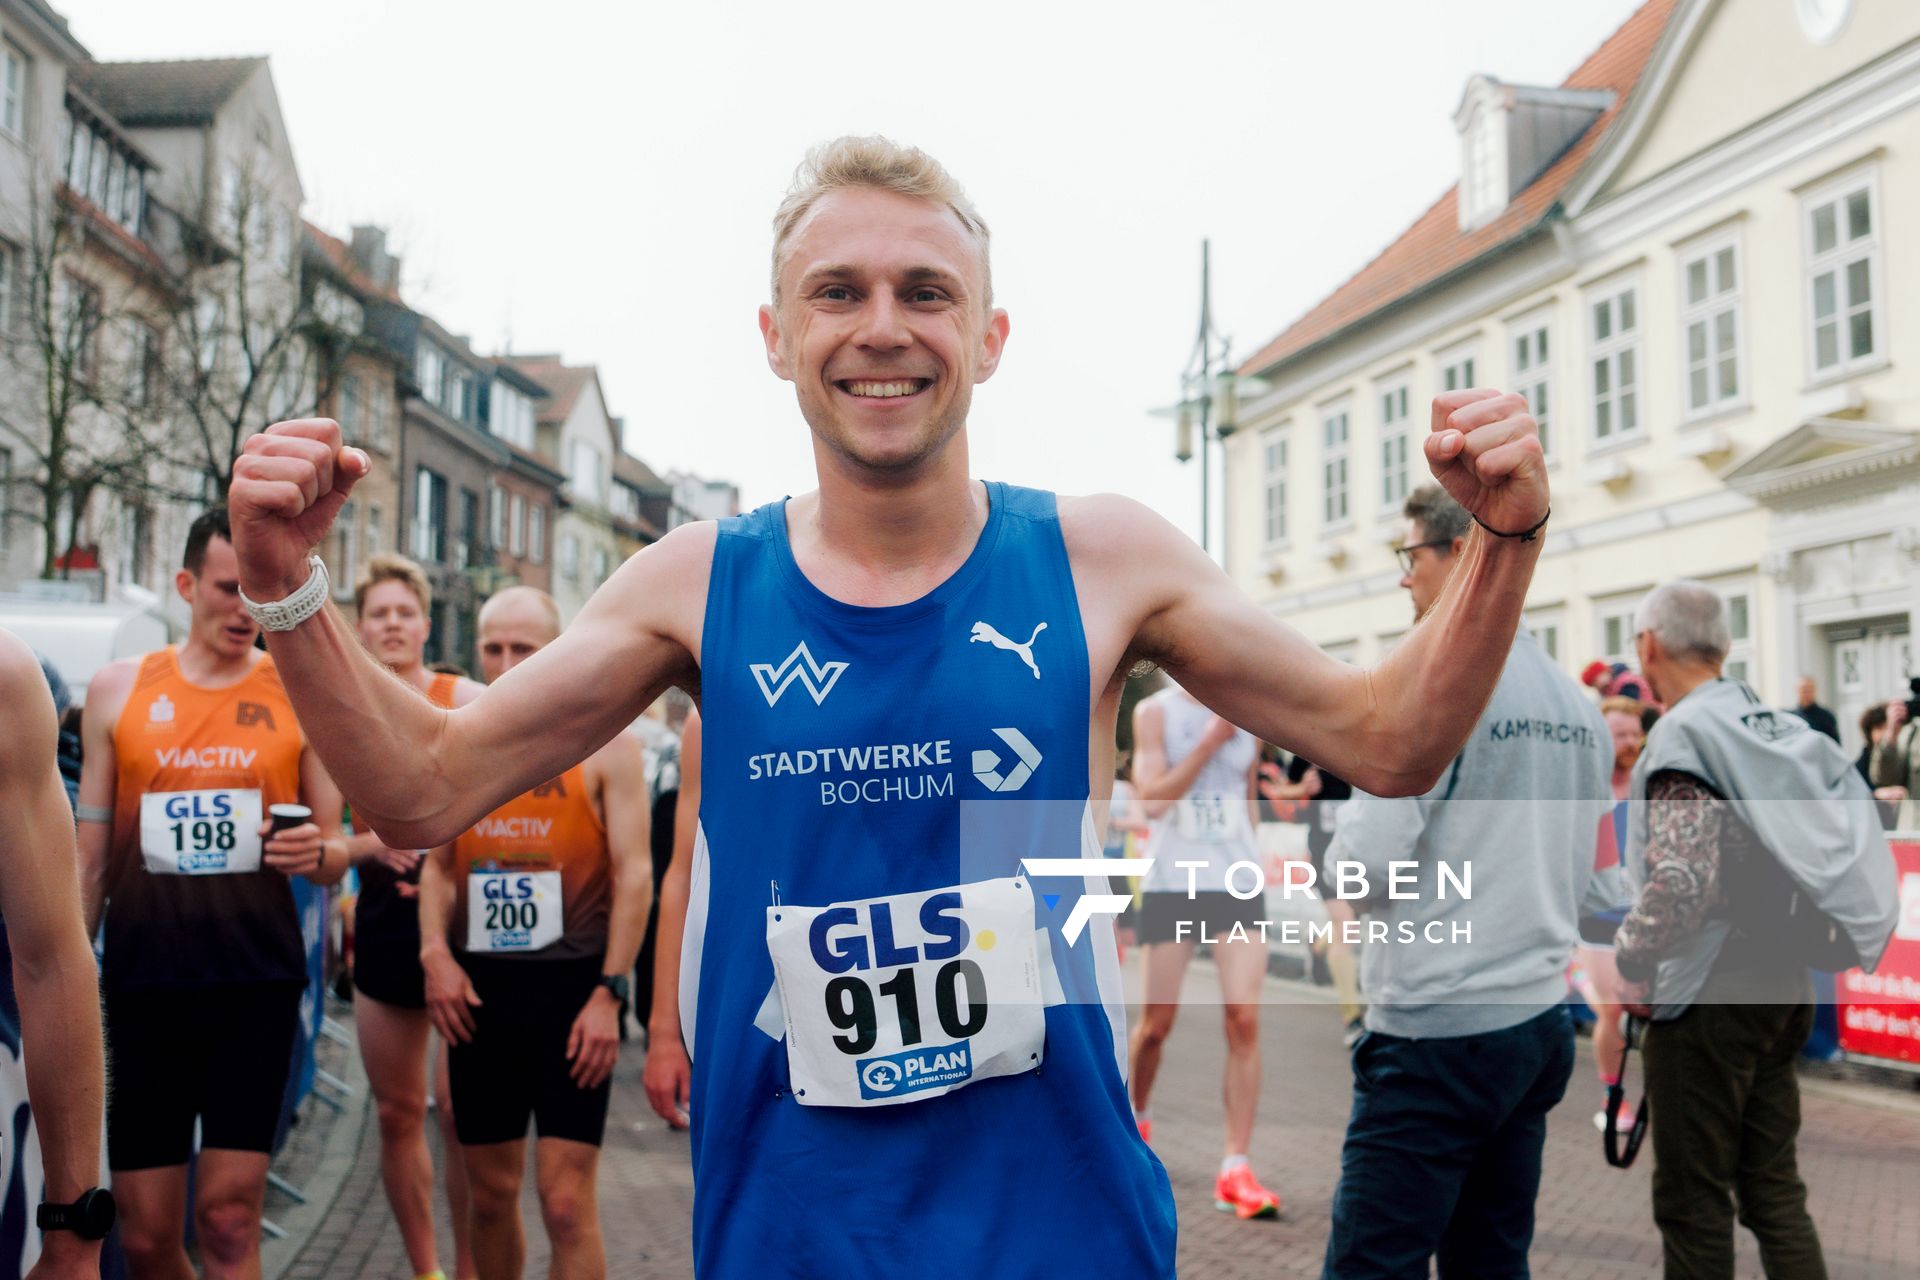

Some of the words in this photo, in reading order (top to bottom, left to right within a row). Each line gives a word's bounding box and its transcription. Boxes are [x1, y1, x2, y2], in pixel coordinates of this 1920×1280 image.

[155, 746, 257, 769] VIACTIV
[748, 739, 952, 780] STADTWERKE
[820, 772, 954, 805] BOCHUM
[169, 821, 236, 851] 198
[474, 817, 553, 838] VIACTIV
[485, 902, 538, 930] 200
[824, 959, 988, 1056] 910
[904, 1050, 967, 1077] PLAN
[908, 1071, 967, 1087] INTERNATIONAL
